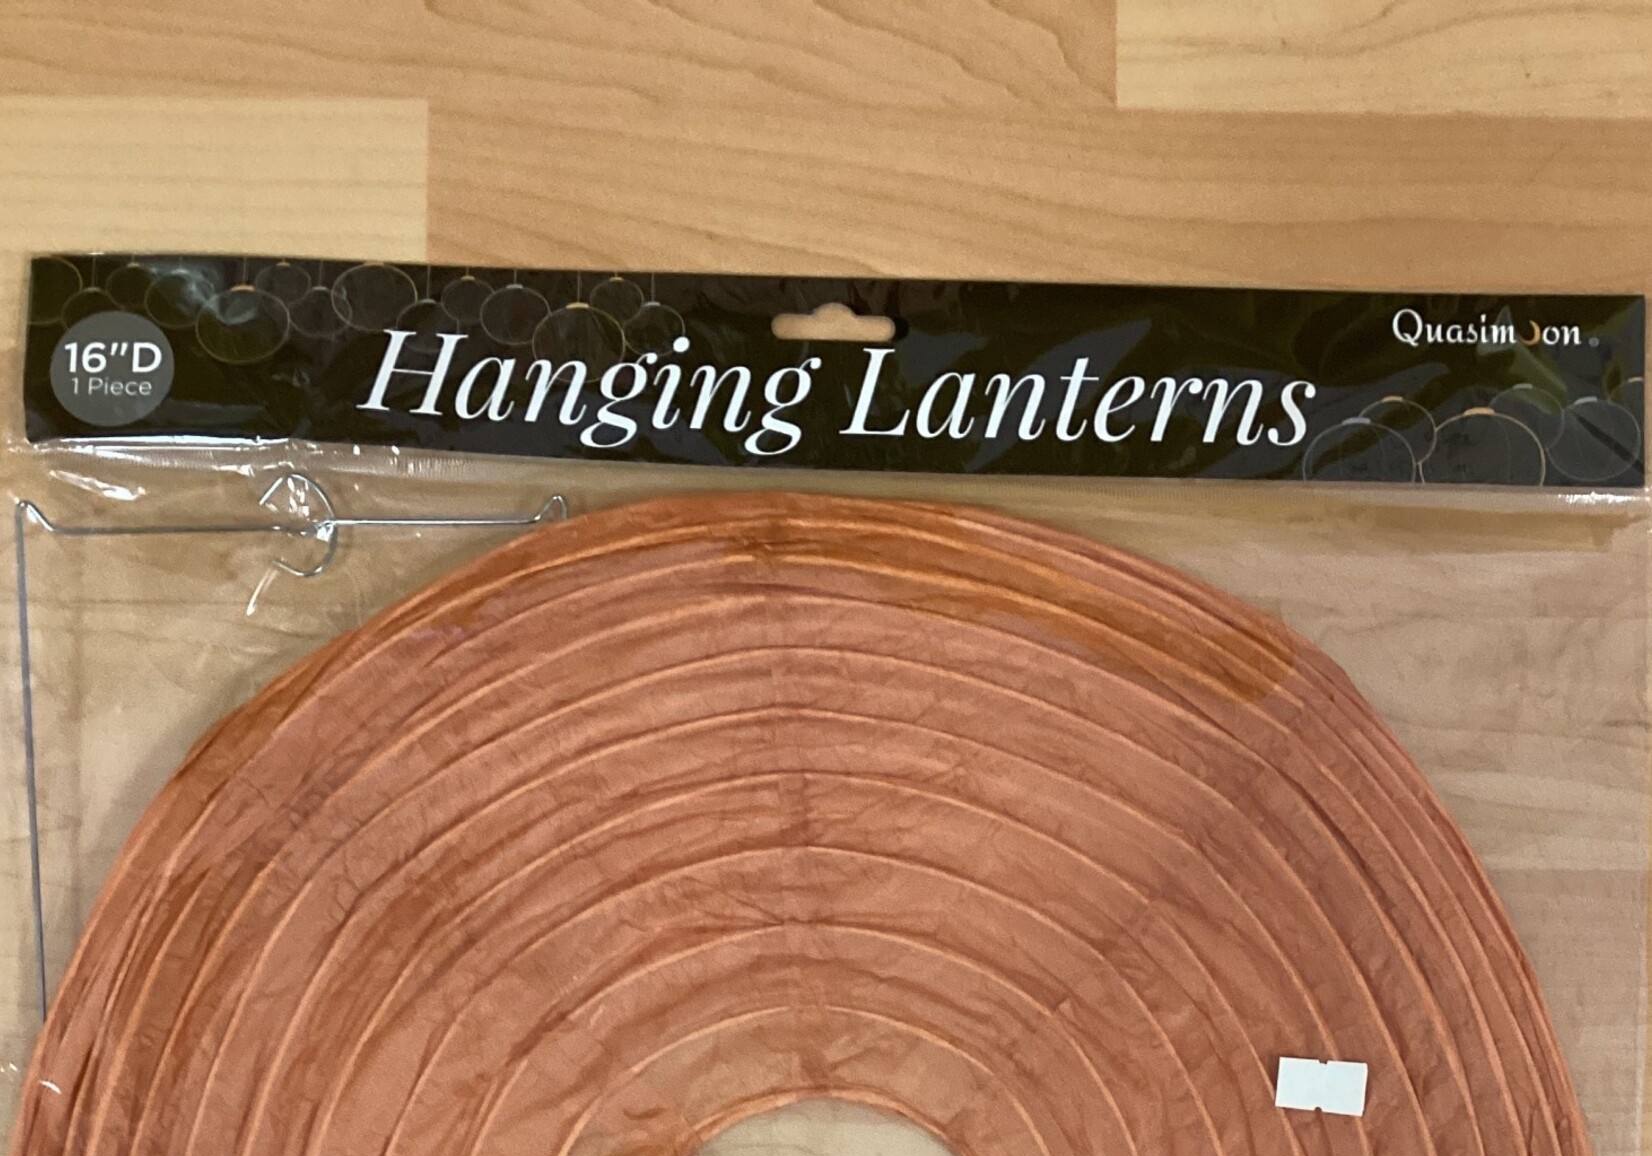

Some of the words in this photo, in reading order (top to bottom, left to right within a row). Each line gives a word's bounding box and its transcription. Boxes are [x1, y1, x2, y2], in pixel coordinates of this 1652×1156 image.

[71, 377, 79, 395] 1
[88, 376, 152, 396] Piece
[356, 328, 821, 456] Hanging
[840, 347, 1317, 448] Lanterns
